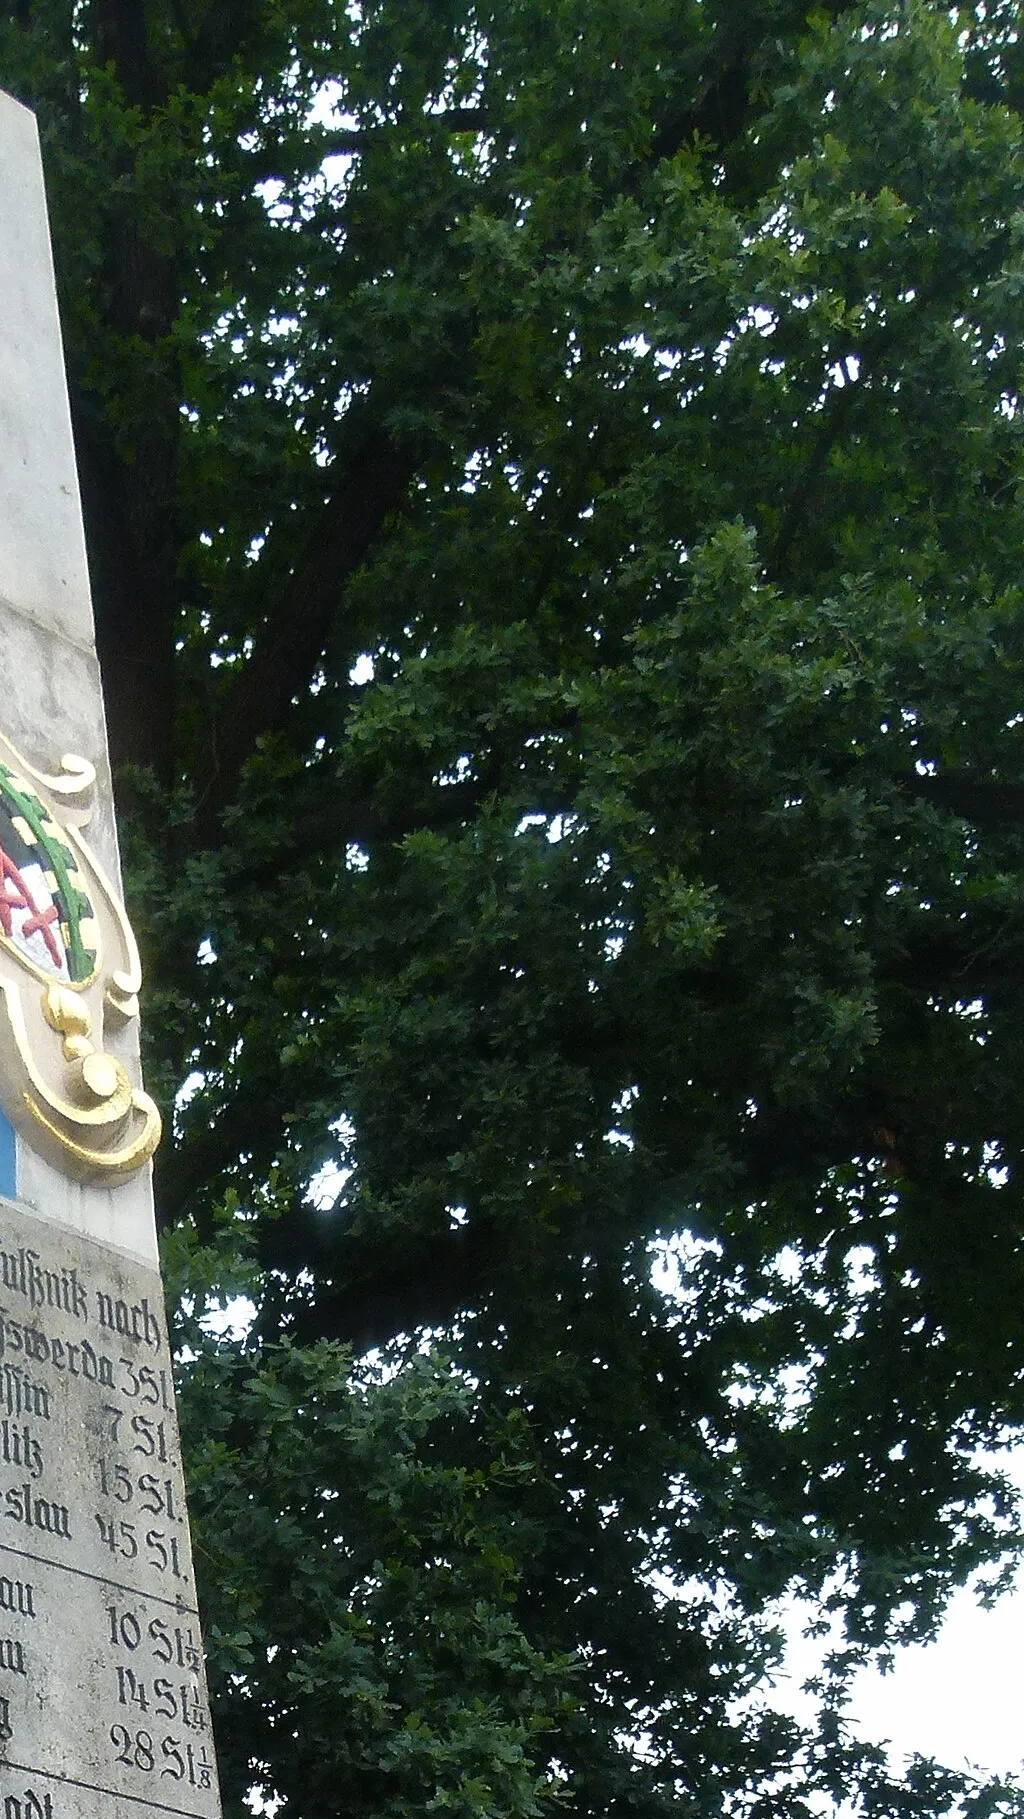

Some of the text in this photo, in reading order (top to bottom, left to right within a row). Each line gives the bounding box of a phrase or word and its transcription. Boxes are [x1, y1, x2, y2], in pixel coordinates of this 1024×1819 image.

[96, 1291, 161, 1357] nach
[119, 1357, 139, 1396] 3
[97, 1457, 133, 1503] 15
[138, 1473, 184, 1523] St.
[95, 1513, 138, 1559] 45
[145, 1530, 188, 1583] St.
[105, 1606, 141, 1650] 10
[115, 1665, 148, 1713] 14
[109, 1724, 155, 1772] 28
